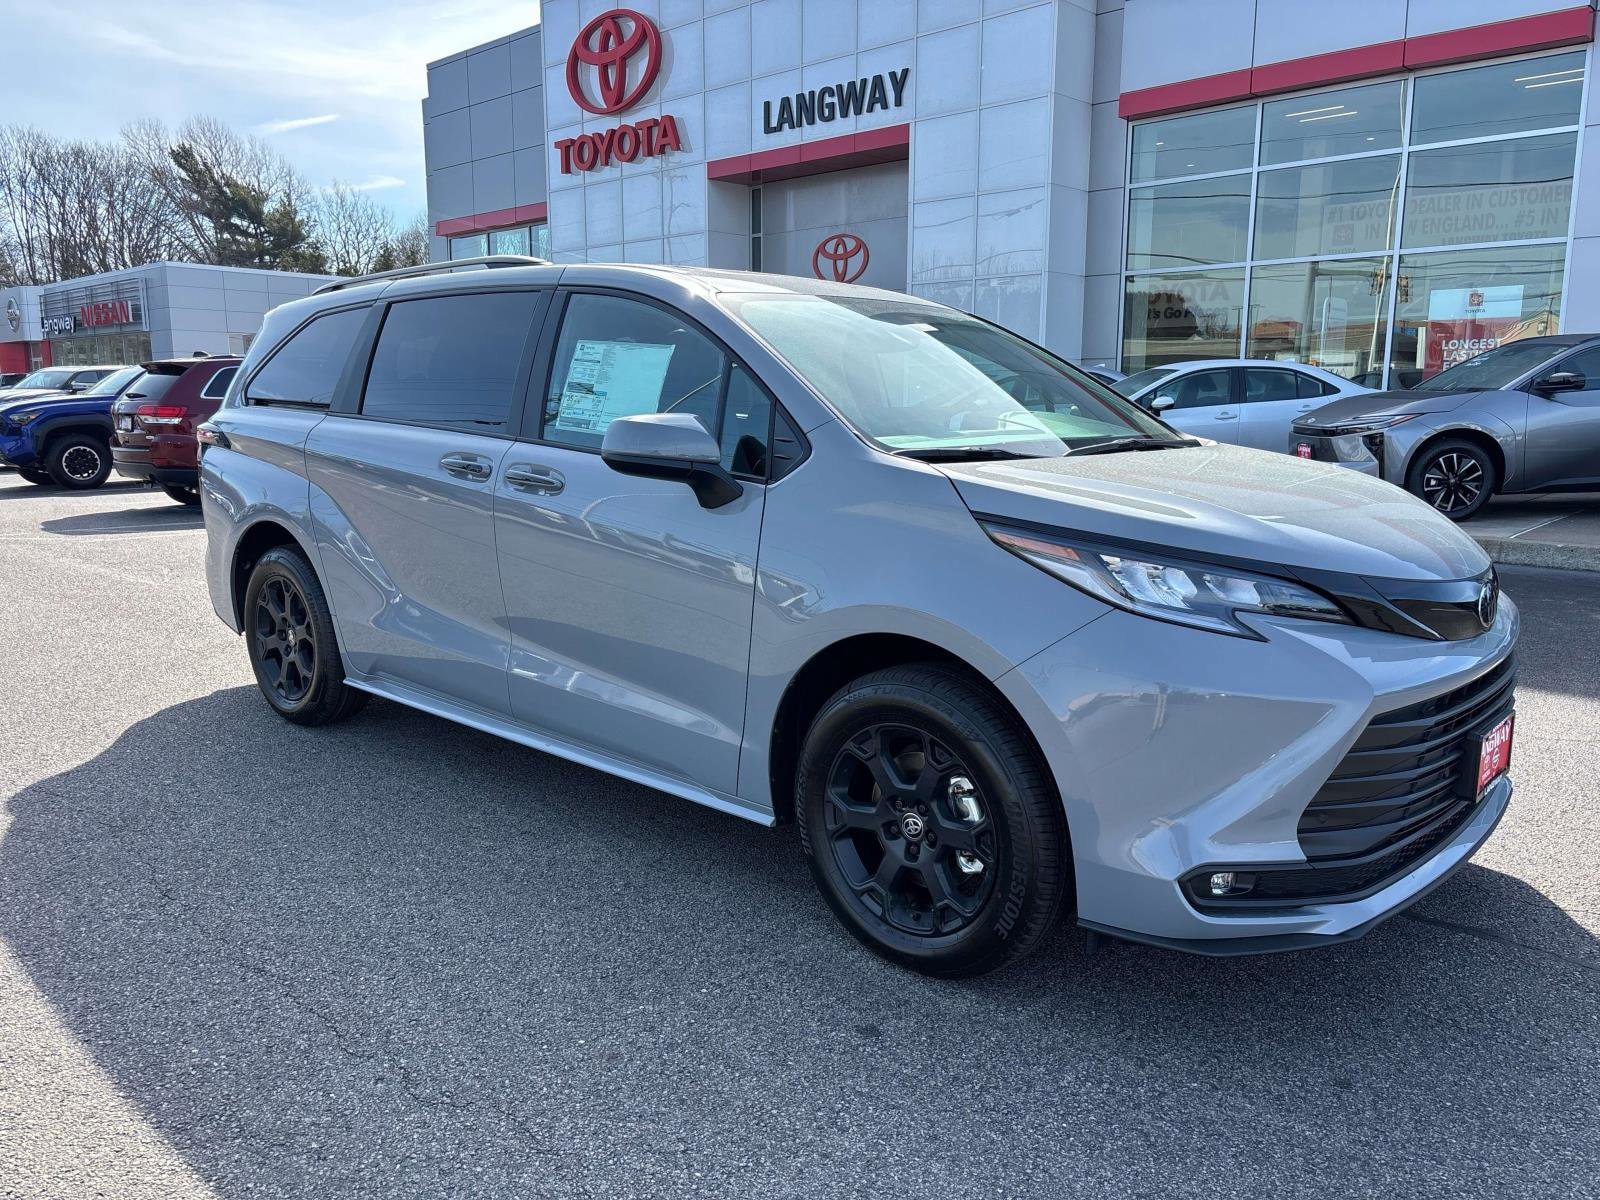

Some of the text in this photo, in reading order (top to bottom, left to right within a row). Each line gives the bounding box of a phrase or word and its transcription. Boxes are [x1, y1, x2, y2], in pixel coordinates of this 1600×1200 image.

[764, 68, 910, 135] LANGWAY
[554, 115, 682, 175] TOYOTA
[1465, 191, 1483, 210] IN
[1364, 222, 1381, 241] IN
[1513, 208, 1536, 228] #5
[1540, 207, 1559, 226] IN
[80, 300, 132, 328] NISSAN
[1164, 306, 1182, 320] Go
[41, 316, 76, 335] Langway
[1441, 338, 1501, 351] LONGEST
